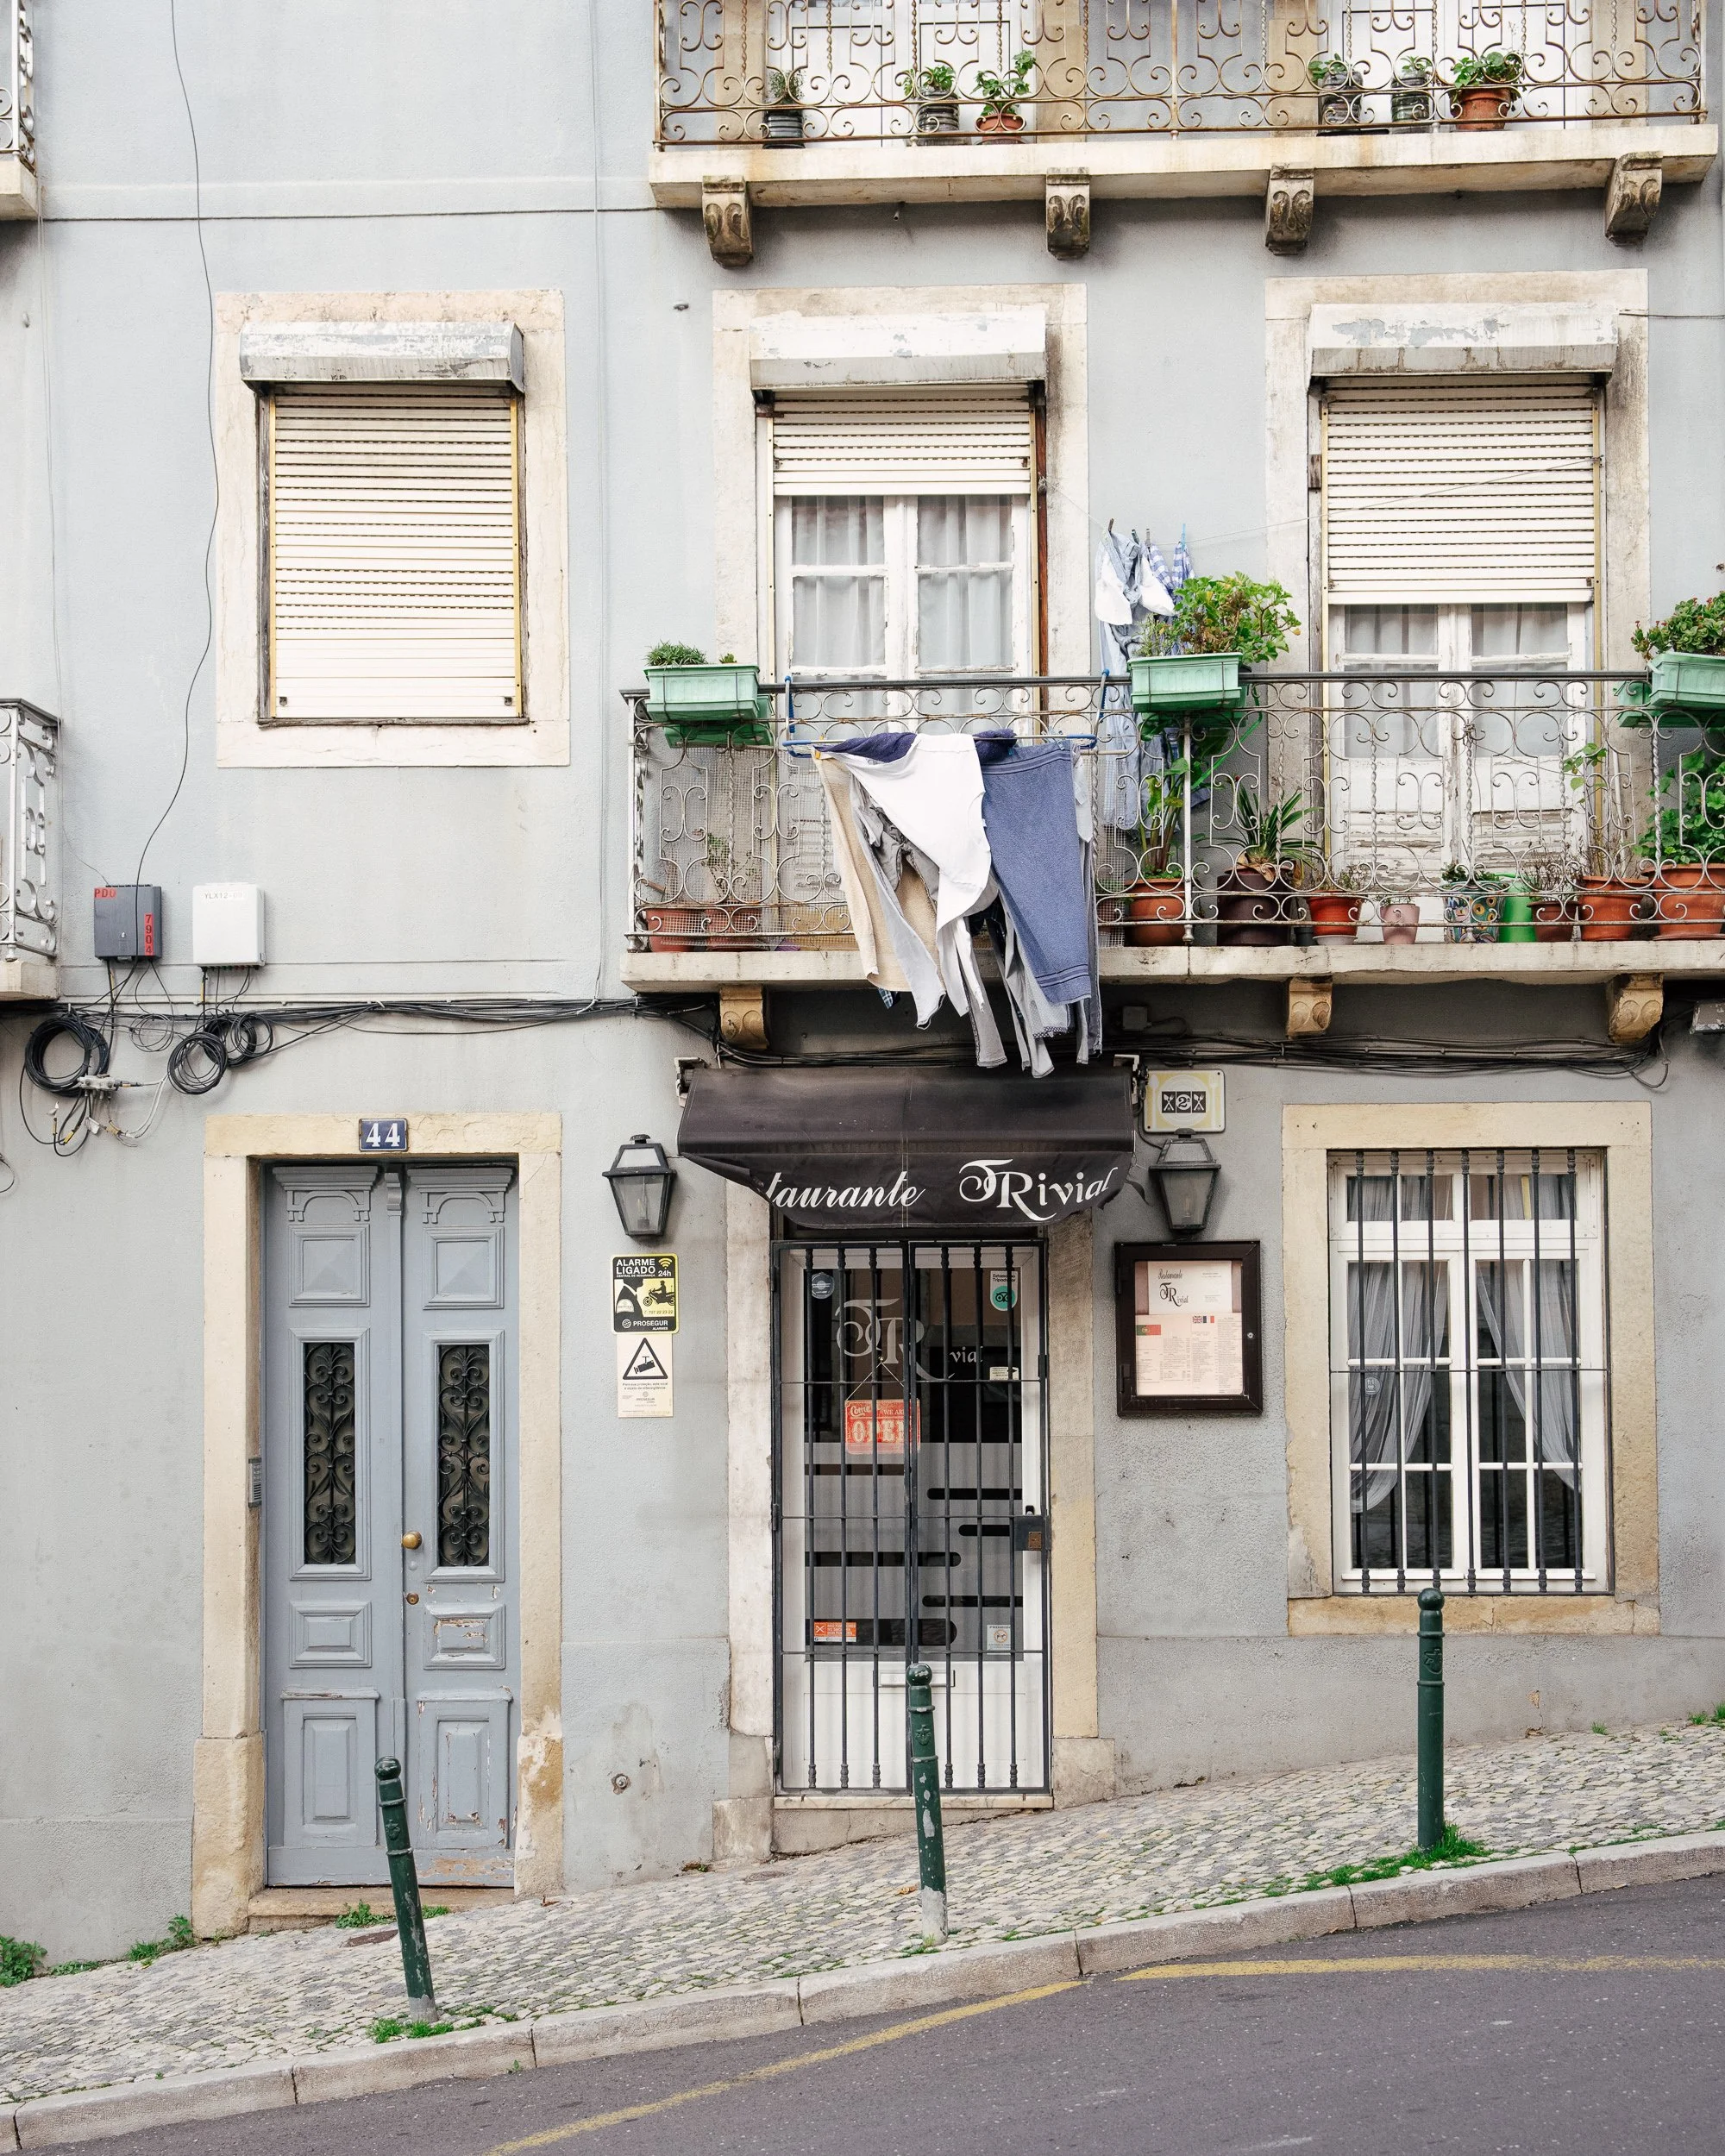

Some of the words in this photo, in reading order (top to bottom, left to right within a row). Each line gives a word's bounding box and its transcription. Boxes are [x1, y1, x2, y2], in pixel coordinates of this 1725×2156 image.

[366, 1123, 400, 1147] 44
[616, 1258, 656, 1267] ALARME
[616, 1266, 656, 1275] LIGADO
